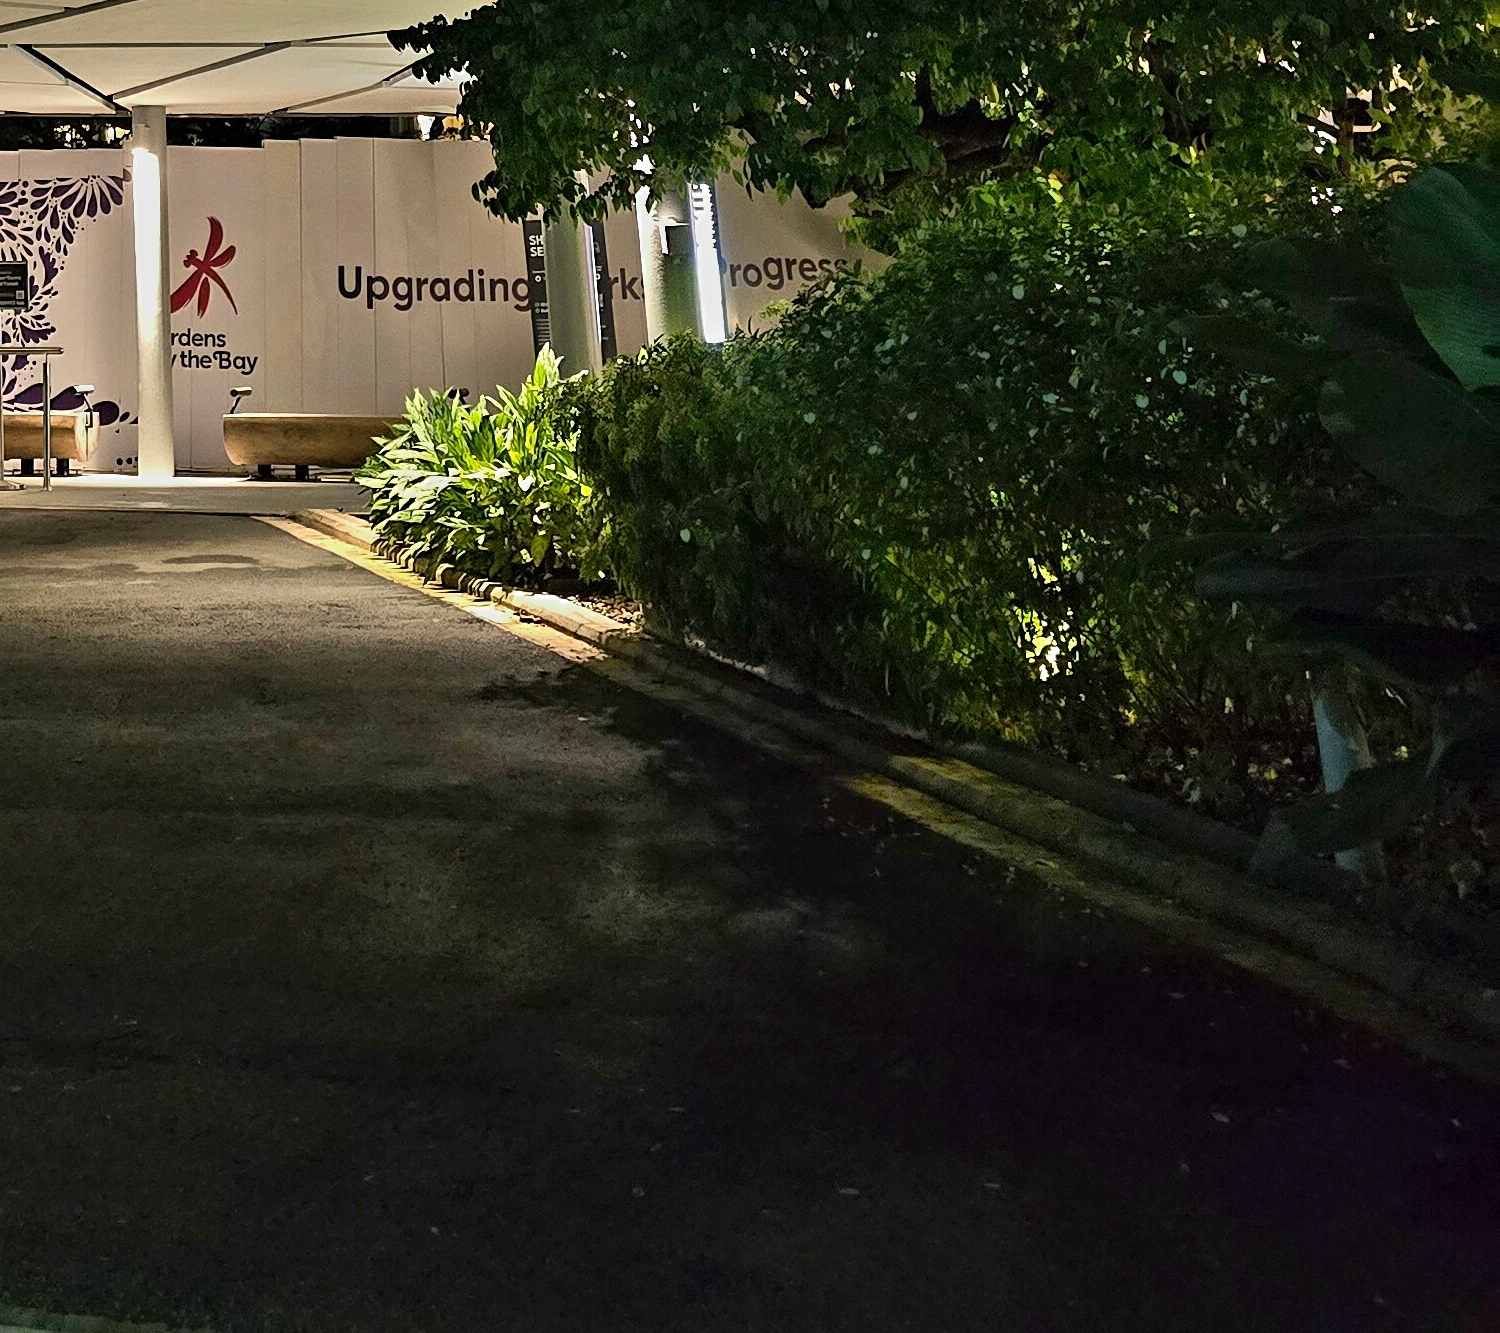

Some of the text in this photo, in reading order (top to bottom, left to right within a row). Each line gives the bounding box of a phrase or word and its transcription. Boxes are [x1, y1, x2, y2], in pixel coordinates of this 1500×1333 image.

[722, 256, 848, 290] rogres
[338, 266, 532, 311] Upgrading
[171, 328, 226, 347] rdens
[180, 350, 212, 368] the
[213, 351, 258, 375] Bay
